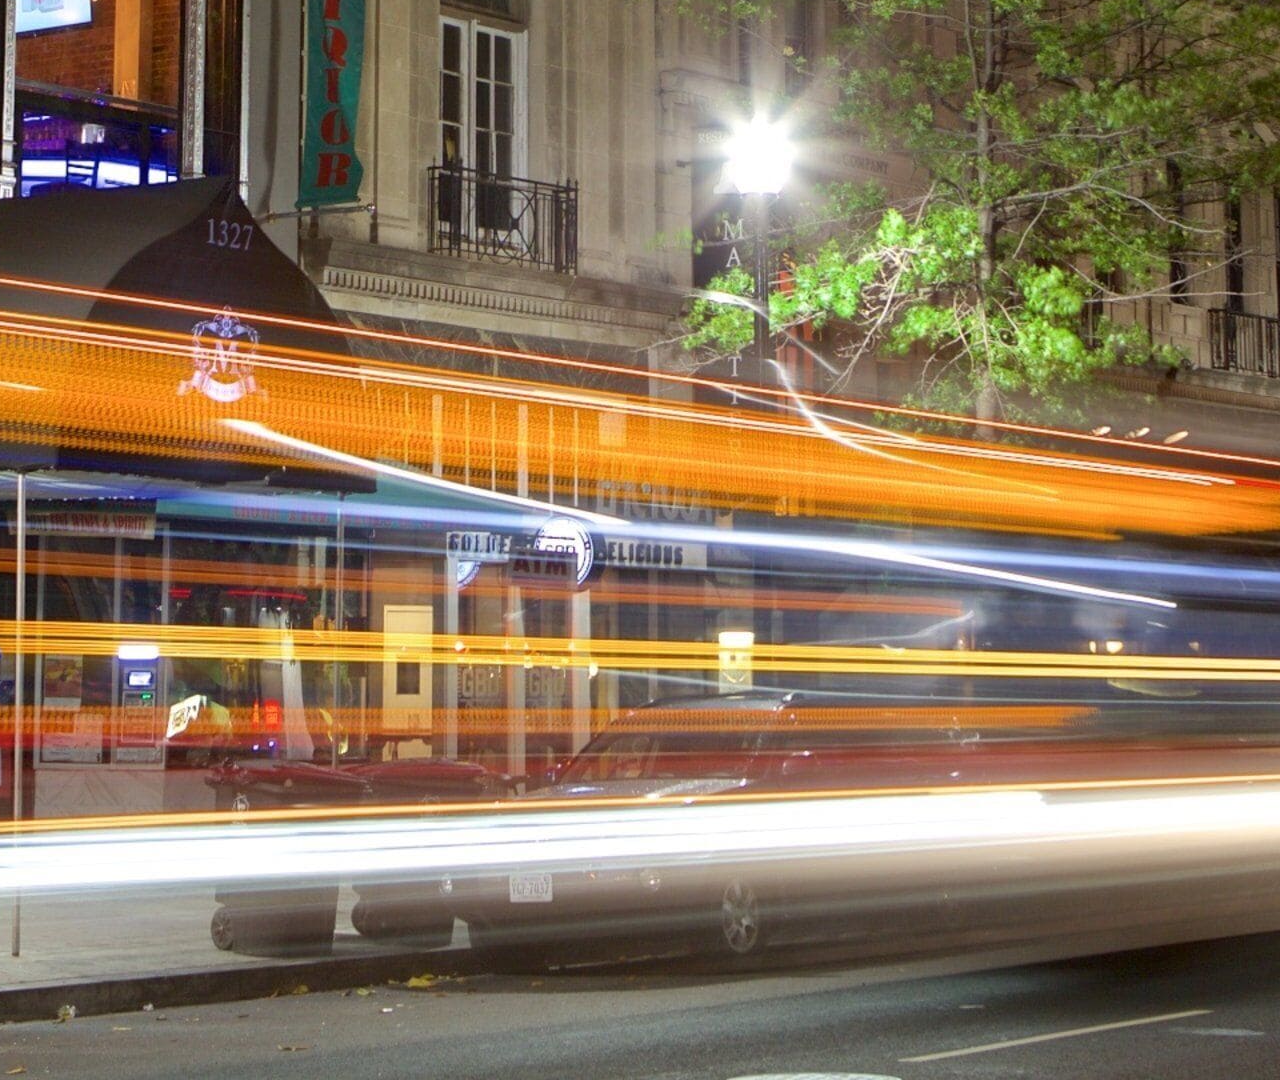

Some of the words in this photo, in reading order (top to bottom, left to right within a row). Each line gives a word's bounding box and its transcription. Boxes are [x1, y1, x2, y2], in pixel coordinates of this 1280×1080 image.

[207, 218, 254, 251] 1327
[596, 541, 684, 565] ELICIOUS
[512, 556, 567, 576] ATM
